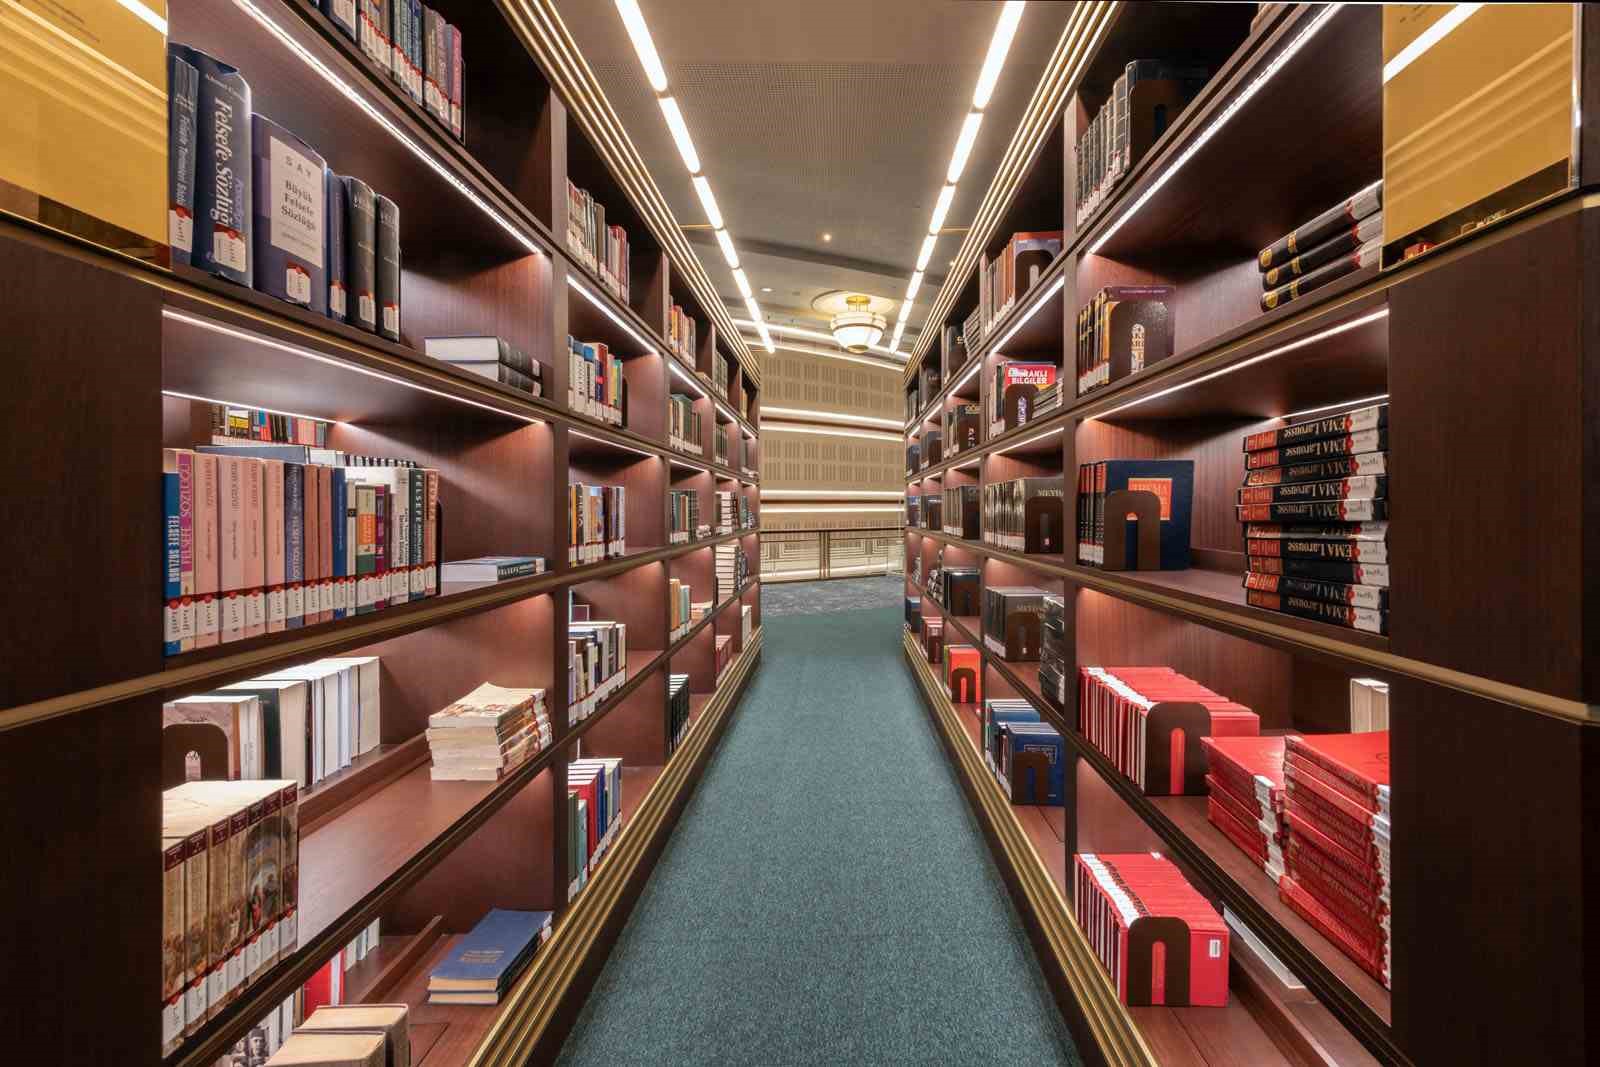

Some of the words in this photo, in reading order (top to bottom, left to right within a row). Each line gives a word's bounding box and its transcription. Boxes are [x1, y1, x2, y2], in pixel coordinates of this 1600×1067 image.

[213, 97, 234, 162] Felsefe
[209, 161, 235, 226] Sözlüğ
[1284, 422, 1320, 441] Larousse
[1286, 442, 1321, 460] Larousse
[1279, 484, 1316, 501] Larousse
[1287, 542, 1326, 557] Larousse
[1288, 596, 1323, 616] Larousse
